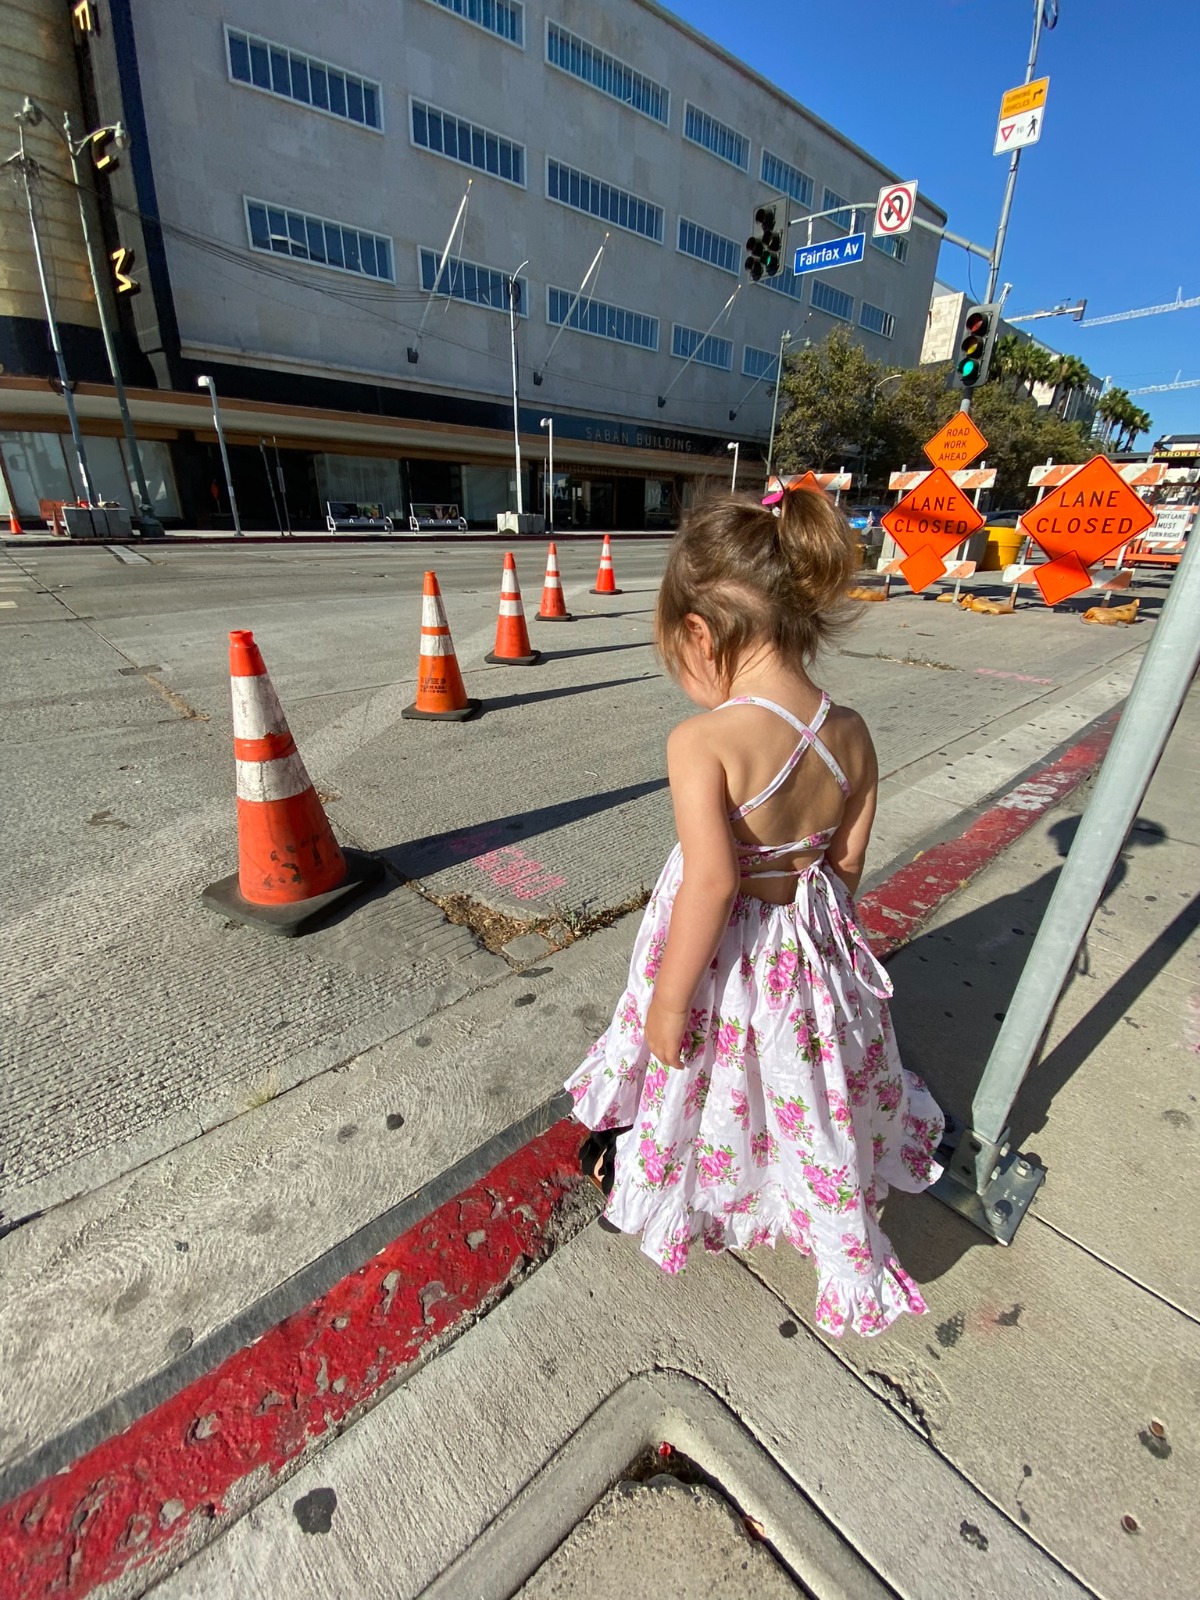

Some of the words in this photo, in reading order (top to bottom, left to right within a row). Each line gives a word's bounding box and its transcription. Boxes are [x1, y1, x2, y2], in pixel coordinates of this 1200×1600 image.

[800, 247, 840, 267] Fairfax
[843, 242, 860, 257] Av
[585, 426, 629, 444] SABAN
[636, 433, 692, 452] BUILDING
[946, 427, 970, 437] ROAD
[943, 440, 967, 449] WORK
[938, 452, 968, 461] AHEAD
[911, 496, 957, 512] LANE
[1059, 490, 1121, 508] LANE
[894, 518, 968, 535] CLOSED
[1036, 517, 1133, 534] CLOSED
[1157, 522, 1177, 530] MUST
